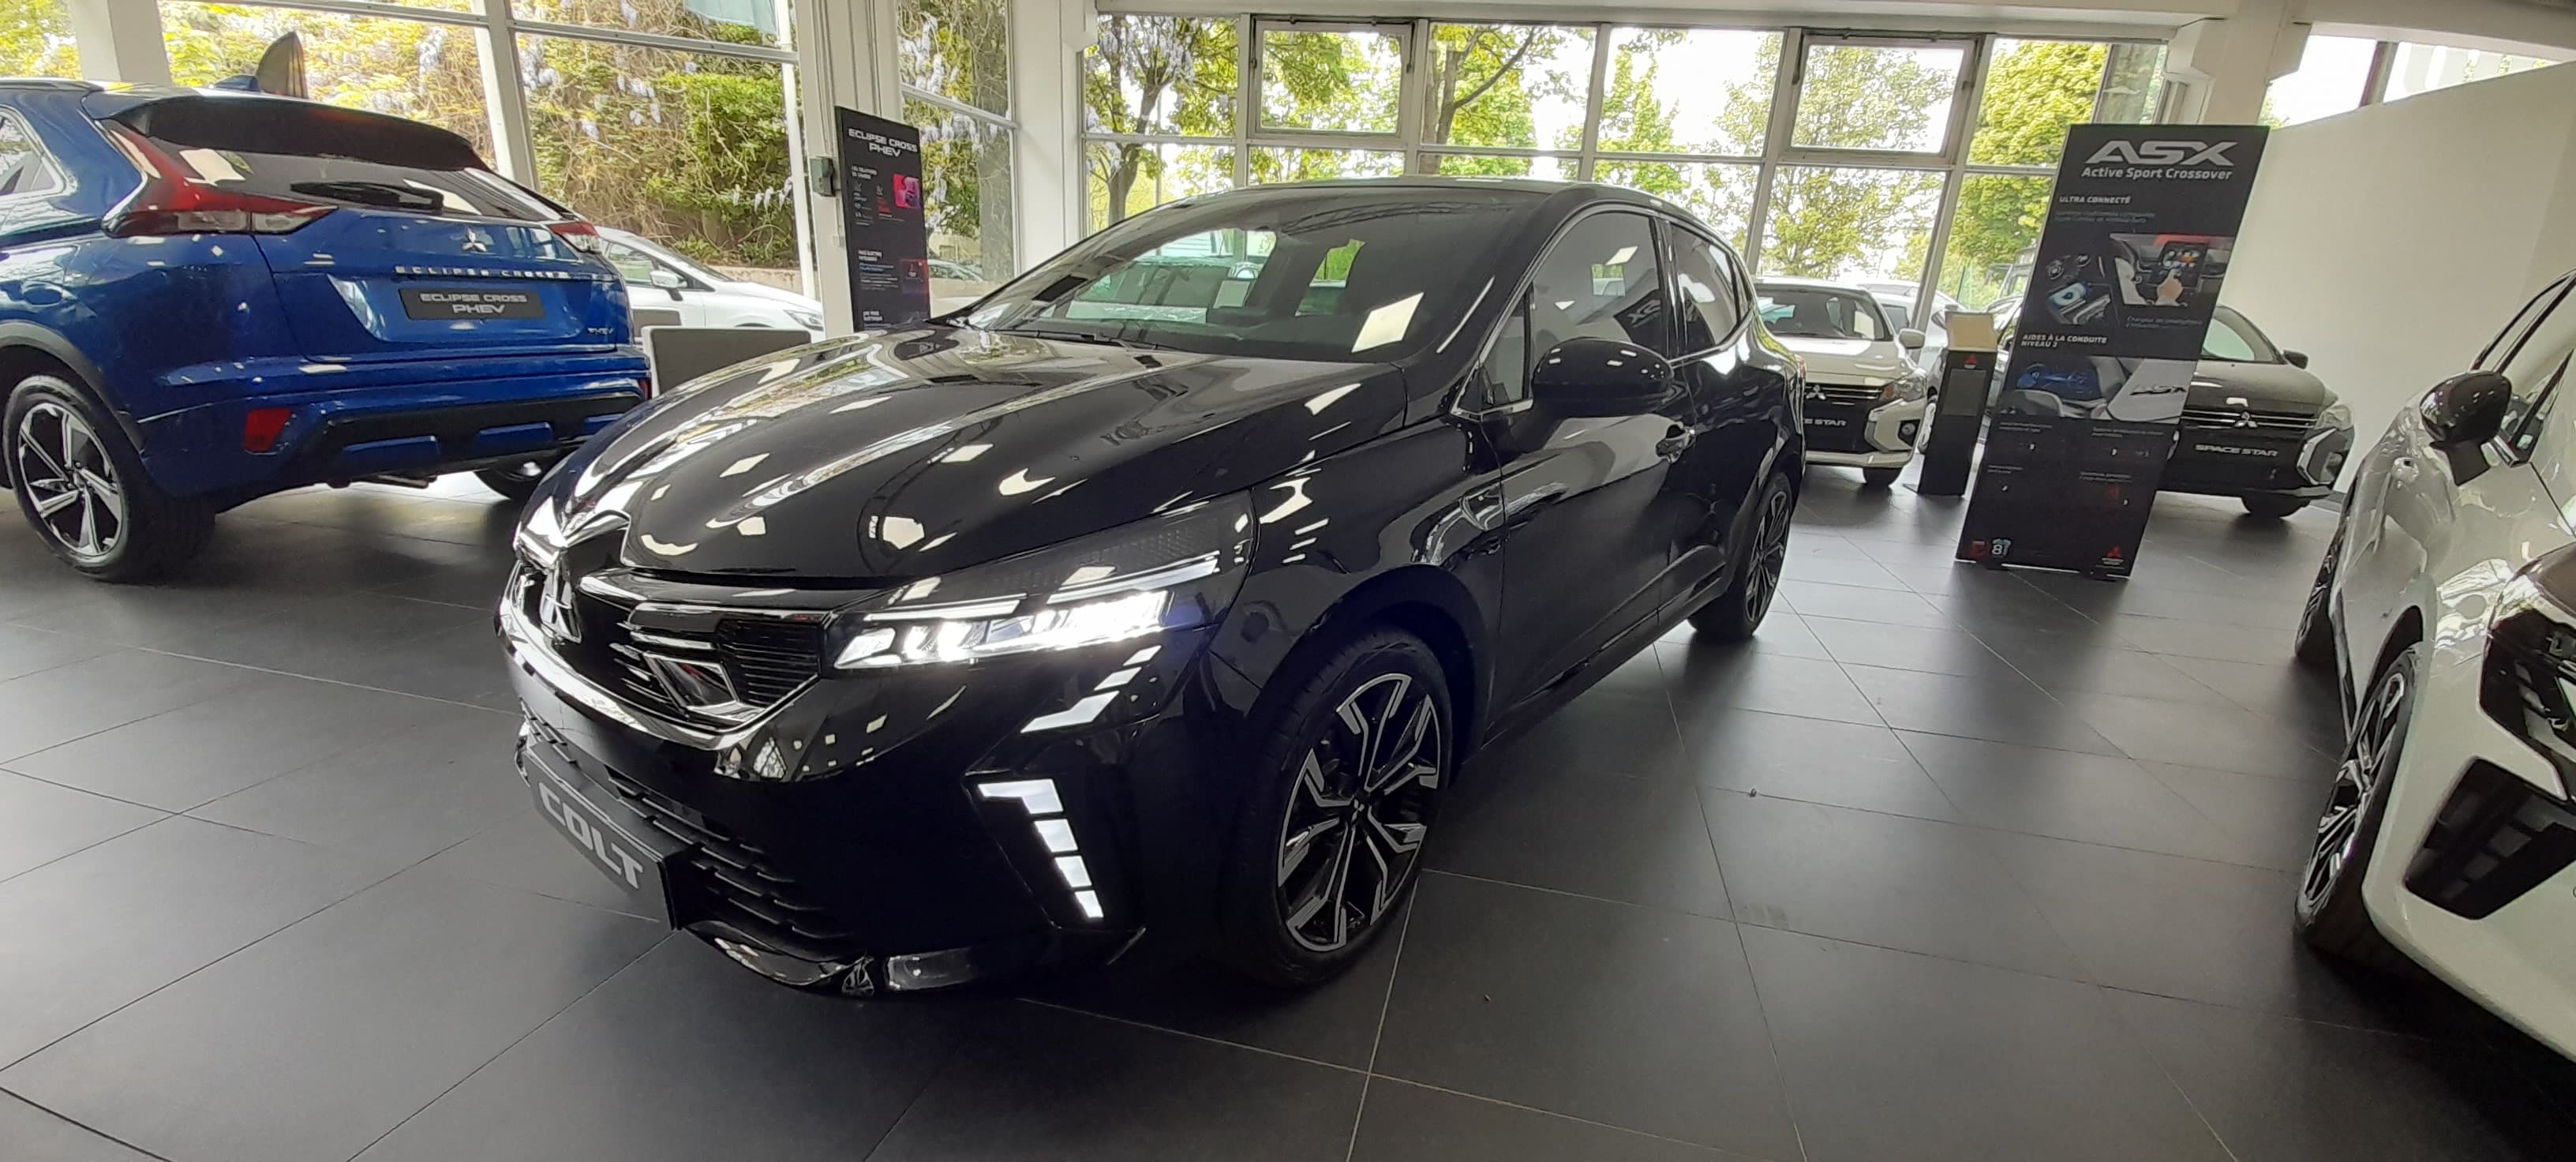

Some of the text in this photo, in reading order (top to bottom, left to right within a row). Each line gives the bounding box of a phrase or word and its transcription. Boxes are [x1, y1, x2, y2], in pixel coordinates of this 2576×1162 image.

[848, 128, 918, 152] ECLIPSE CROSS
[869, 142, 901, 157] PHEV
[2084, 140, 2238, 167] ASX
[2081, 167, 2233, 180] Active Sport Crossover
[419, 293, 527, 303] ECLIPSE CROSS
[451, 304, 506, 314] PHEV
[2020, 339, 2052, 347] NIVEAU
[2066, 335, 2107, 344] CONDUITE
[2241, 448, 2278, 457] STAR
[538, 782, 643, 890] COLT
